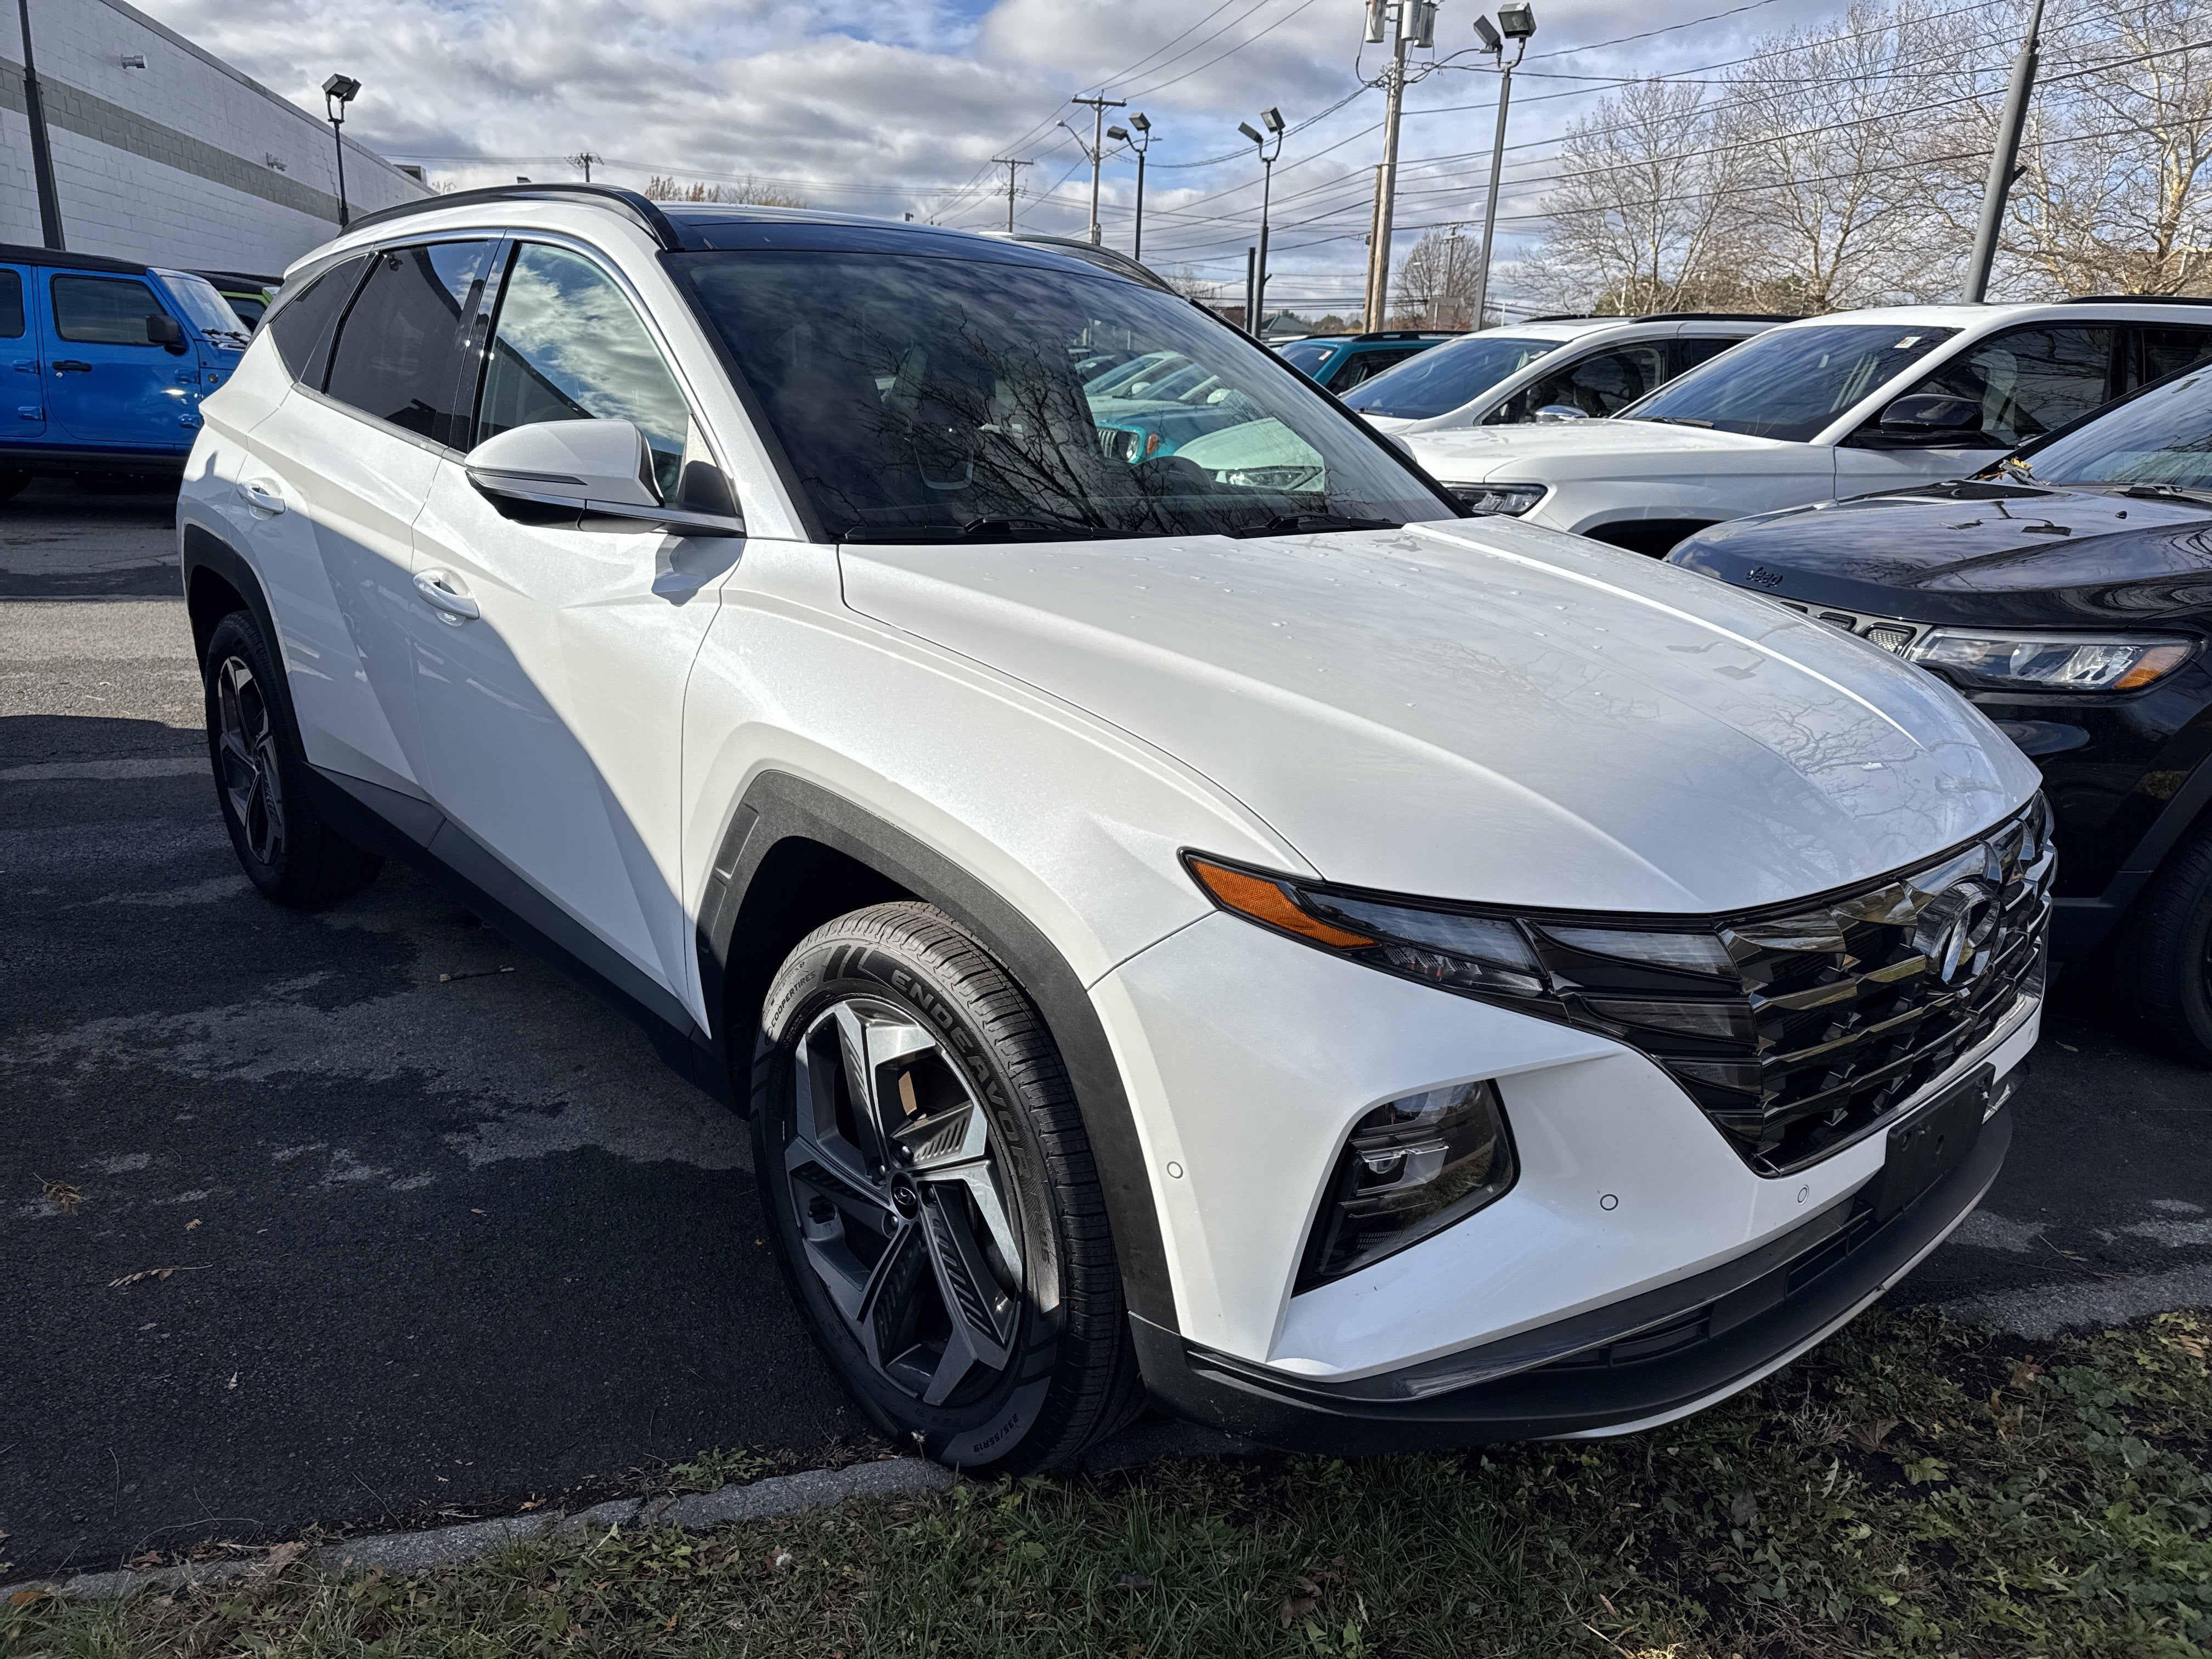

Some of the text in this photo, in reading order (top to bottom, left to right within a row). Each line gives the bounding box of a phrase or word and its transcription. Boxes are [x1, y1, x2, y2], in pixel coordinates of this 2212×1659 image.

[1746, 566, 1783, 588] Jeep
[890, 969, 1032, 1181] ENDEAVOR
[973, 1413, 1019, 1453] 235/55R19
